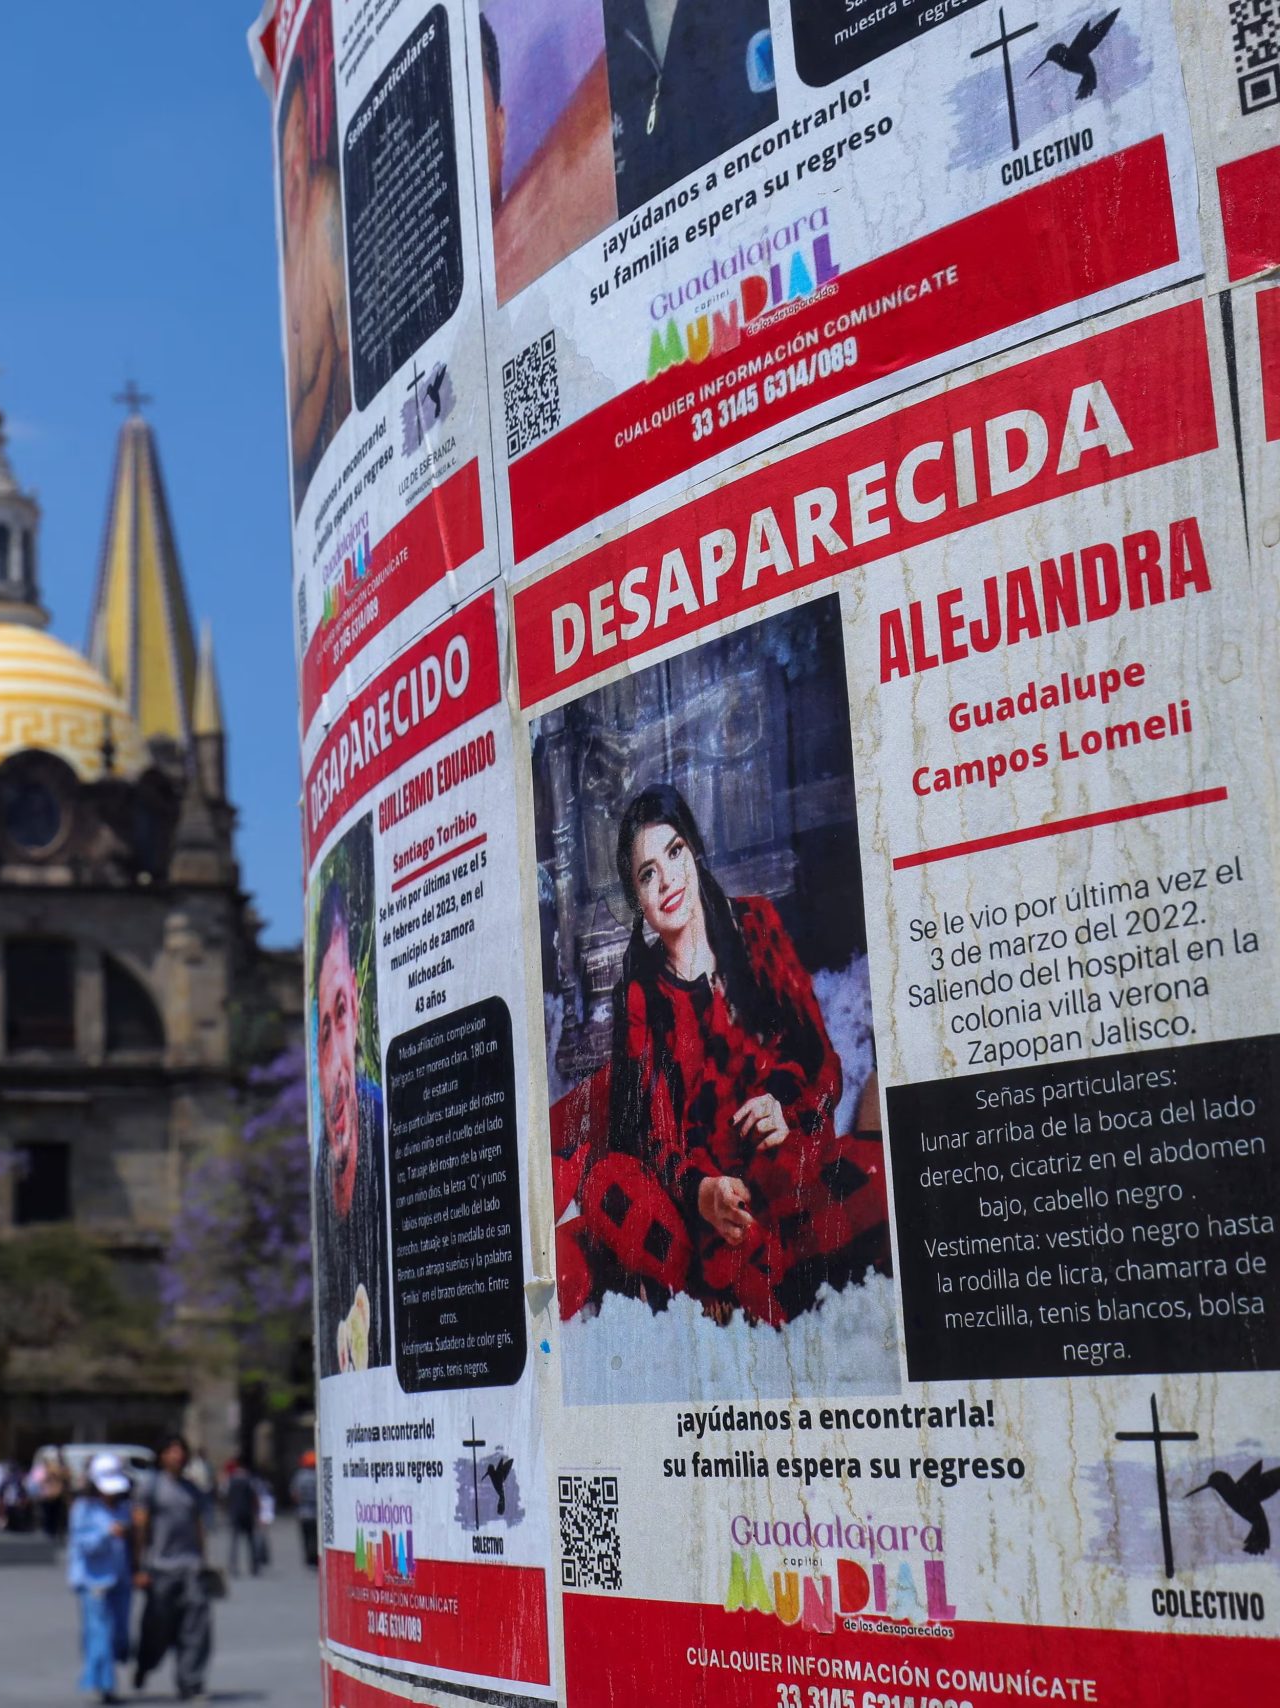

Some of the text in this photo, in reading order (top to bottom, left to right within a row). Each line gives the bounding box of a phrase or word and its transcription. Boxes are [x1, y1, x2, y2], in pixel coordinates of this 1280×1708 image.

[834, 1, 897, 45] muestra
[347, 107, 372, 151] Señas
[372, 23, 436, 119] particulares
[603, 79, 872, 262] ¡ayúdanos a encontrarlo!
[1001, 128, 1094, 186] COLECTIVO
[590, 116, 893, 305] su familia espera su regreso
[649, 206, 830, 321] Guadalajara
[646, 233, 841, 384] MUNDIAL
[747, 284, 839, 336] de los desaparecidos
[614, 264, 960, 448] CUALQUIER INFORMACIÓN COMUNÍCATE
[691, 336, 858, 442] 33 3145 6314/089
[551, 380, 1134, 675] DESAPARECIDA
[879, 516, 1212, 685] ALEJANDRA
[948, 662, 1146, 733] Guadalupe
[310, 634, 470, 832] DESAPARECIDO
[912, 699, 1193, 797] Campos Lomeli
[378, 730, 496, 834] GUILLERMO EDUARDO
[393, 809, 477, 874] Santiago Toribio
[379, 851, 487, 923] Se le vio por última vez el 5
[909, 855, 1243, 942] Se le vio por última vez el
[383, 881, 484, 947] de febrero del 2023, en el
[930, 900, 1207, 971] 3 de marzo del 2022.
[391, 919, 475, 971] municipio de zamora
[908, 929, 1260, 1008] Saliendo del hospital en la
[408, 958, 455, 989] Michoacán.
[415, 990, 447, 1014] 43 años
[950, 976, 1210, 1035] colonia villa verona
[470, 1040, 498, 1059] 180 cm
[967, 1014, 1197, 1066] Zapopan Jalisco.
[431, 1078, 459, 1097] estatura
[445, 1090, 505, 1120] tatuaje rostro
[975, 1067, 1177, 1110] Señas particulares:
[486, 1116, 503, 1132] lado
[920, 1095, 1256, 1152] lunar arriba de la boca del lado
[478, 1144, 502, 1165] virgen
[487, 1170, 507, 1184] unos
[919, 1134, 1266, 1188] derecho, cicatriz en el abdomen
[484, 1197, 500, 1211] lado
[979, 1181, 1183, 1222] bajo, cabello negro
[496, 1223, 511, 1237] san
[924, 1214, 1274, 1260] Vestimenta: vestido negro hasta
[484, 1250, 513, 1267] palabra
[937, 1251, 1267, 1294] la rodilla de licra, chamarra de
[488, 1277, 510, 1291] Entre
[945, 1291, 1265, 1330] mezclilla, tenis blancos, bolsa
[476, 1331, 496, 1346] color
[1062, 1341, 1132, 1366] negra.
[382, 1417, 435, 1441] encontrarlo!
[677, 1399, 996, 1438] ¡ayúdanos a encontrarla!
[395, 1460, 443, 1484] su regreso
[663, 1451, 1026, 1487] su familia espera su regreso
[472, 1535, 504, 1556] COLECTIVO
[730, 1511, 945, 1558] Guadalajara
[724, 1551, 957, 1635] MUNDIAL
[1151, 1588, 1265, 1621] COLECTIVO
[844, 1618, 953, 1637] de los desaparecidos
[686, 1647, 783, 1676] CUALQUIER
[787, 1654, 929, 1688] INFORMACIÓN
[936, 1667, 1098, 1702] COMUNÍCATE
